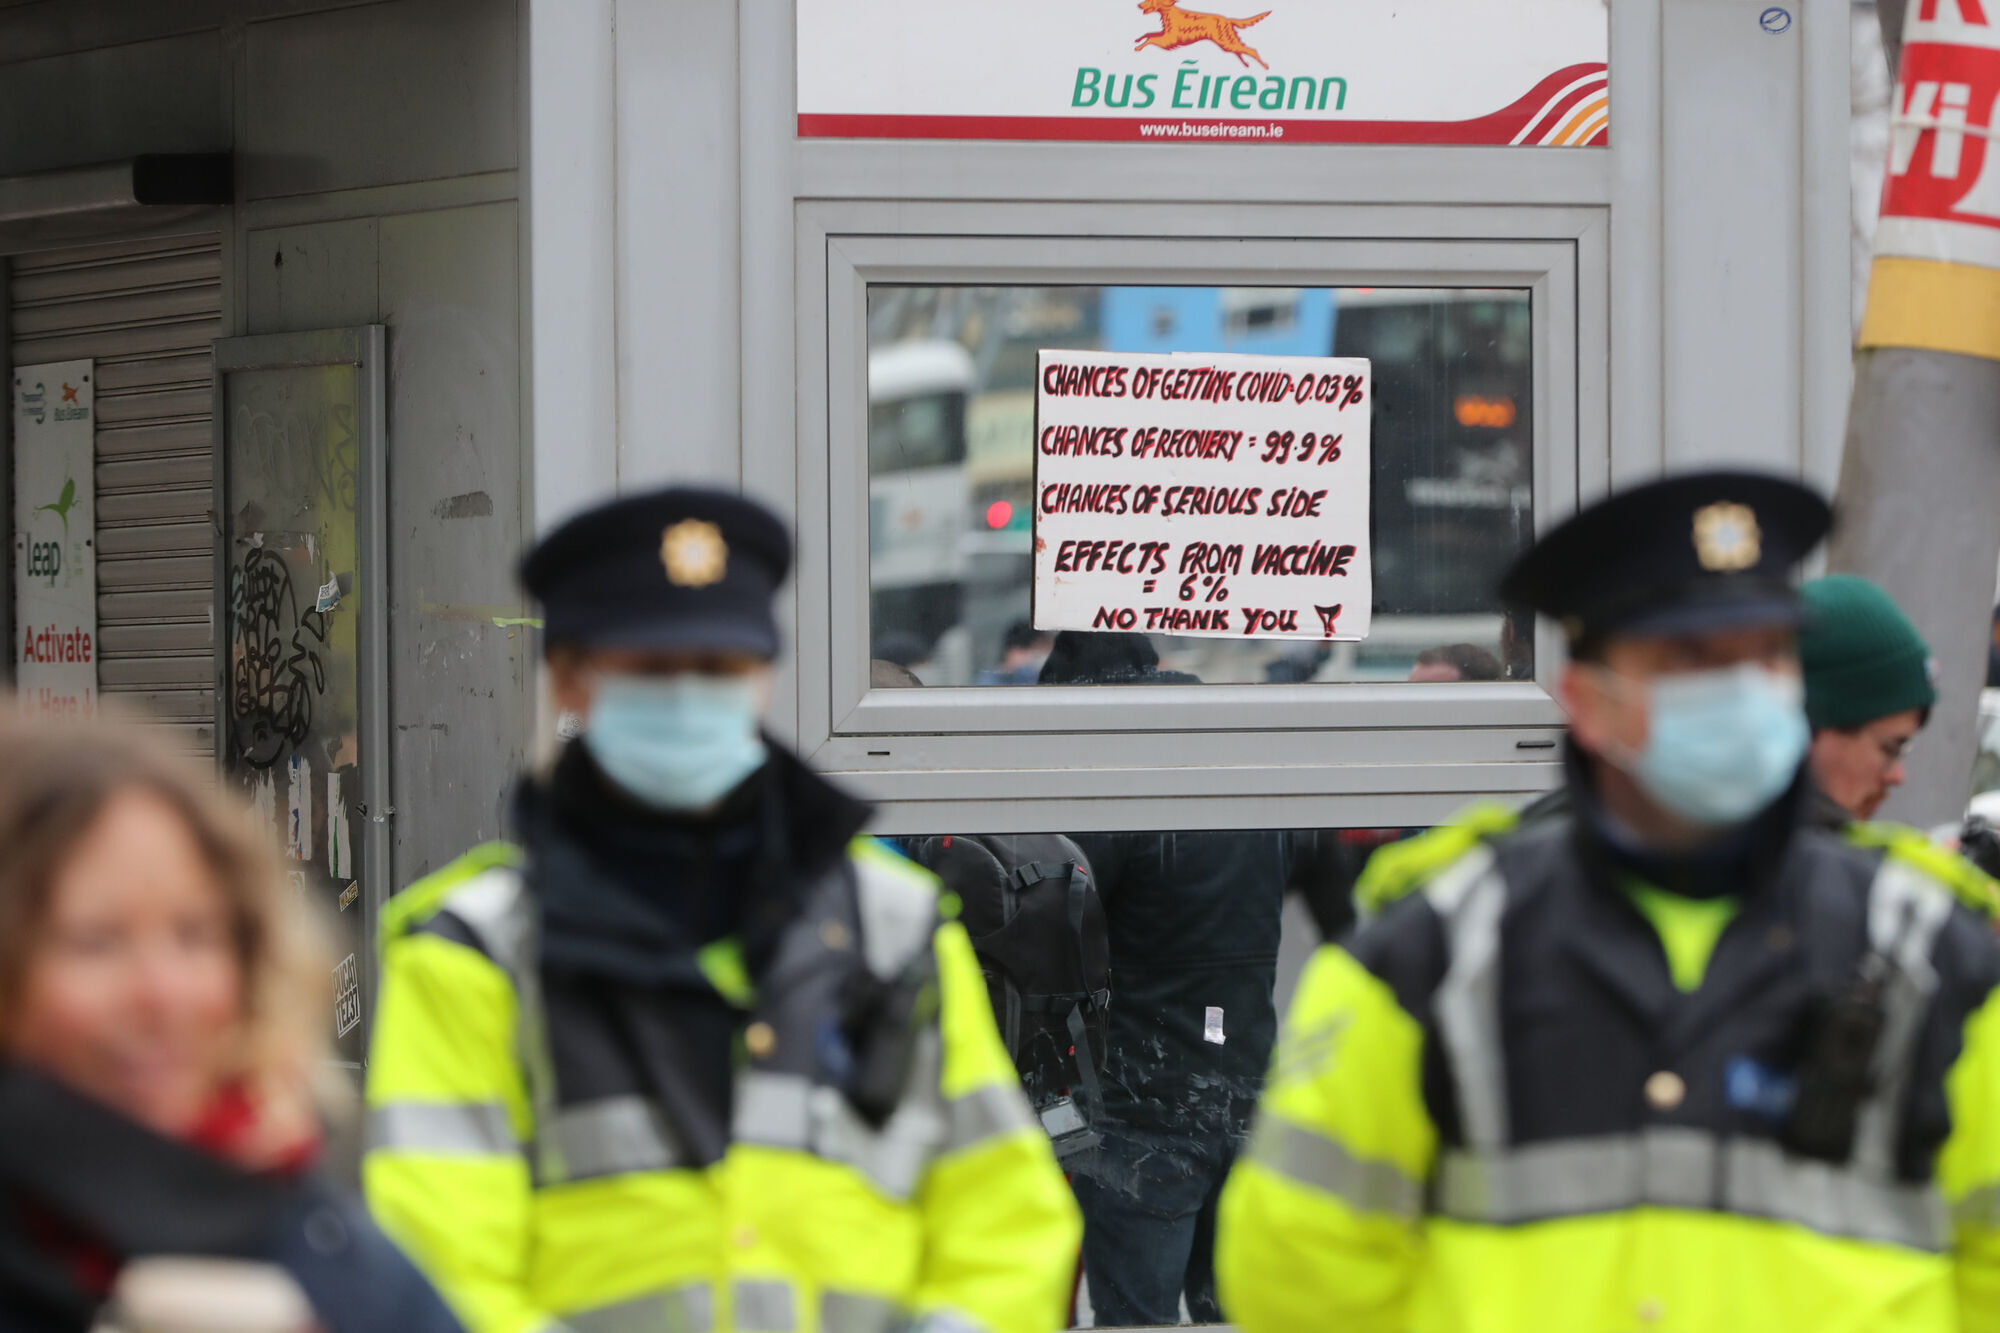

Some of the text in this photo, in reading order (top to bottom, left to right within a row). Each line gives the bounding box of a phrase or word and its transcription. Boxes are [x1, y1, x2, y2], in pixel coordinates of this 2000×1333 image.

[1071, 67, 1158, 108] Bus
[1139, 121, 1284, 138] www.buseireann.ie
[1043, 363, 1129, 398] CHANCES
[1132, 366, 1163, 399] OF
[1160, 365, 1237, 404] GETTING
[1040, 425, 1128, 458] CHANCES
[1131, 426, 1159, 459] OF
[1153, 428, 1244, 462] RECOVERY
[1260, 430, 1343, 466] 99.9%
[1040, 483, 1328, 517] CHANCES OF SERIOUS SIDE
[1054, 539, 1357, 577] EFFECTS FROM VACCINE
[1179, 574, 1229, 602] 6%
[1092, 606, 1138, 630] NO
[1144, 608, 1229, 630] THANK
[1241, 607, 1298, 635] YOU
[24, 624, 92, 664] Activate
